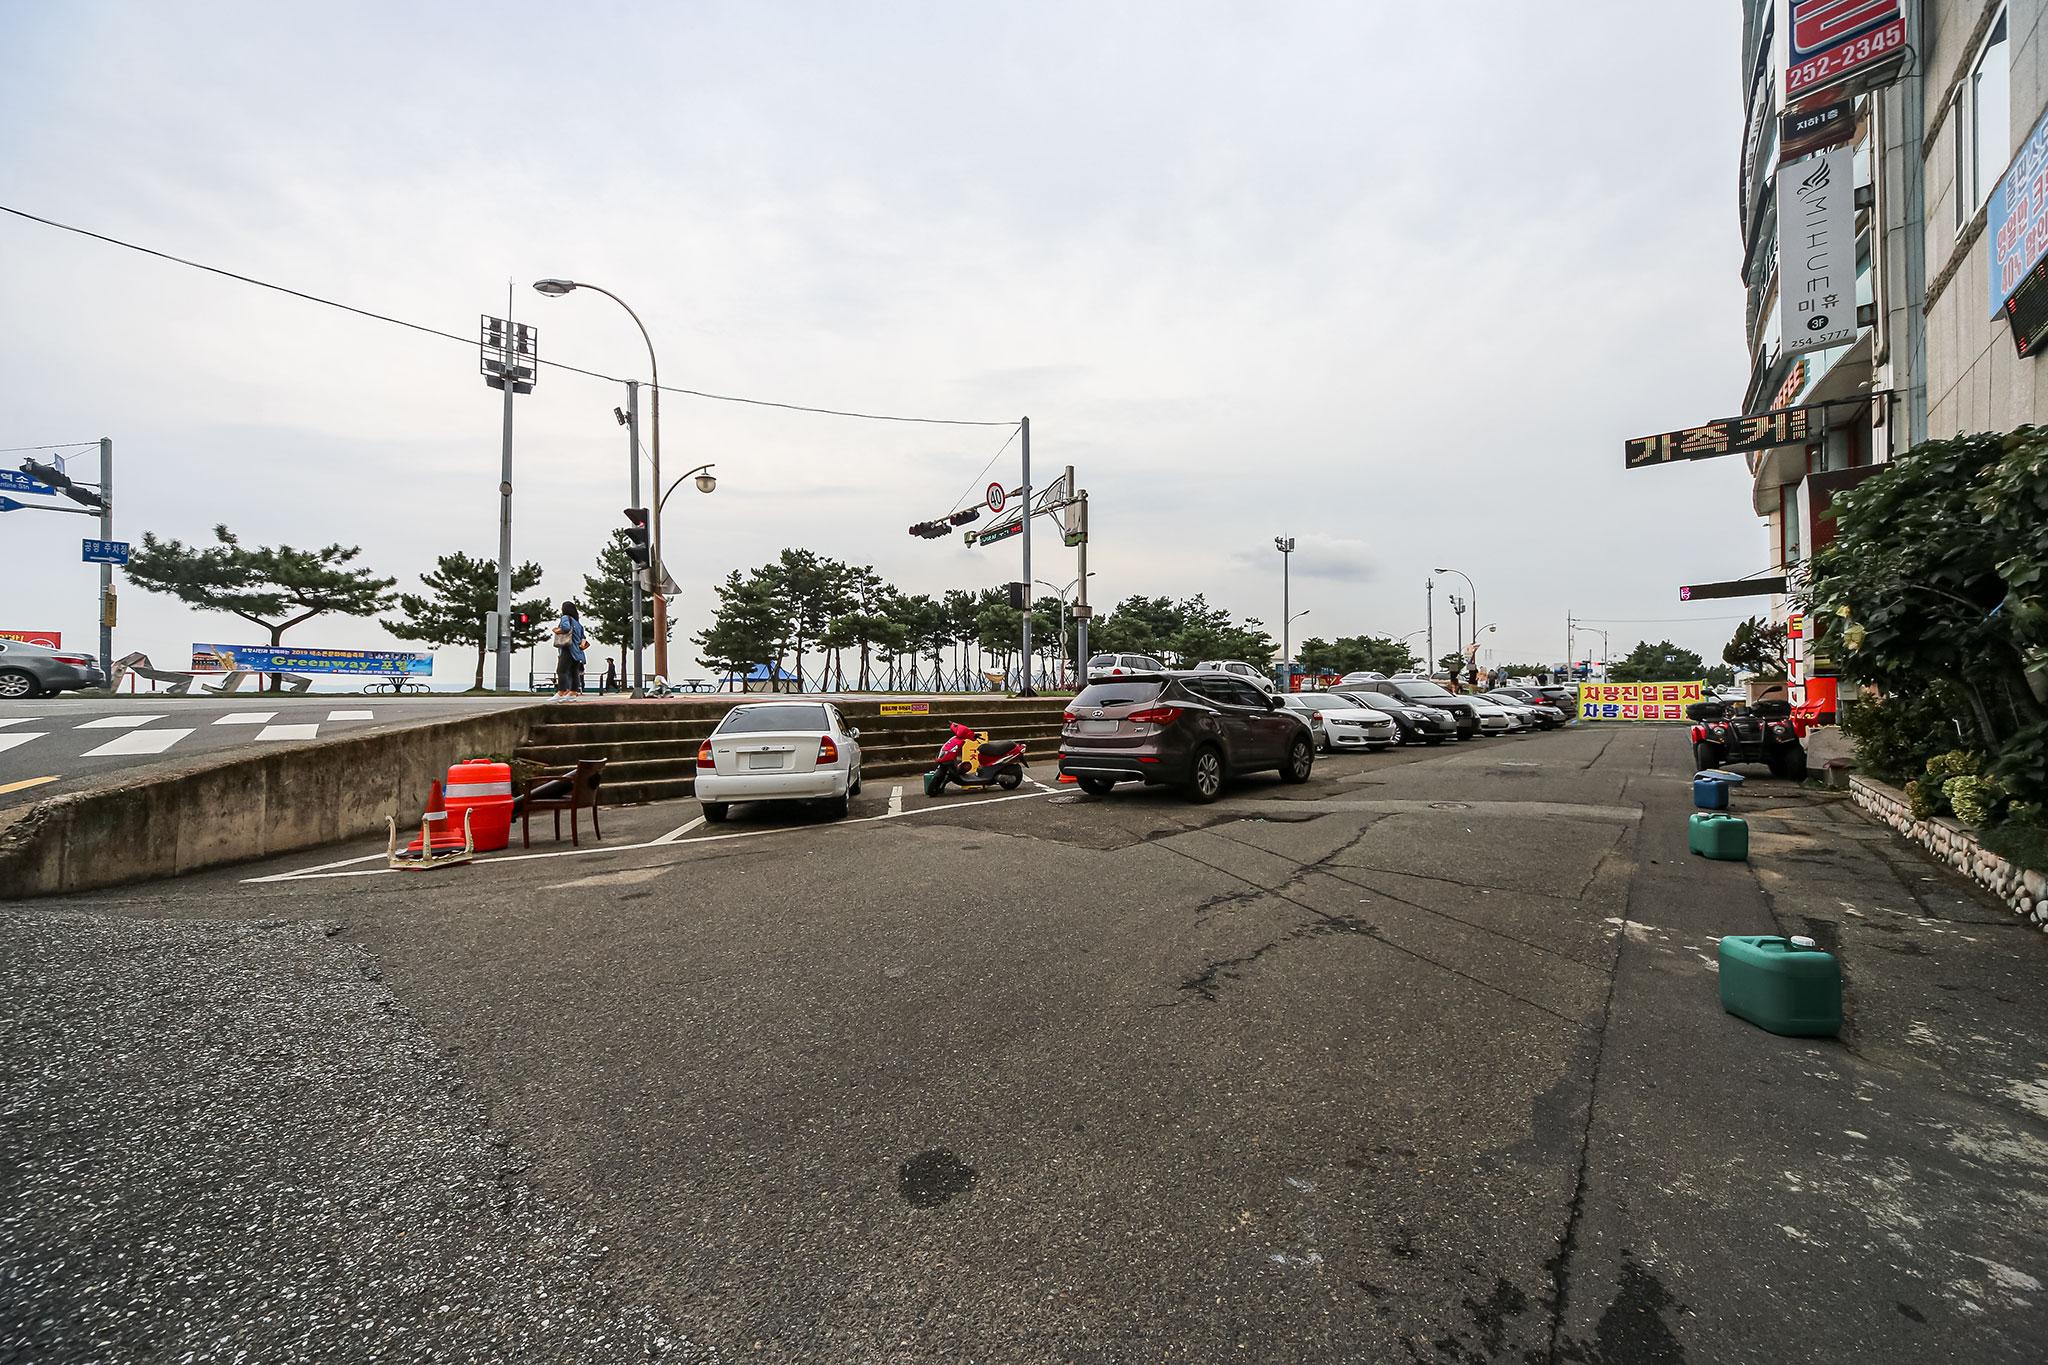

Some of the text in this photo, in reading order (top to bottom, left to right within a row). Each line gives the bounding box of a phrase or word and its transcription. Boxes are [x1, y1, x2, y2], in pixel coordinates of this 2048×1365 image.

[1790, 25, 1900, 89] 252-2345
[1806, 196, 1829, 293] MIHUE
[1798, 294, 1839, 313] 미휴
[1811, 318, 1824, 328] 3F
[1631, 424, 1729, 463] 가족
[1, 473, 29, 484] 역소
[990, 489, 1002, 506] 40
[84, 541, 127, 555] 공영 주차장
[1584, 684, 1700, 701] 차량진입금지
[1583, 703, 1690, 719] 차량진입금
